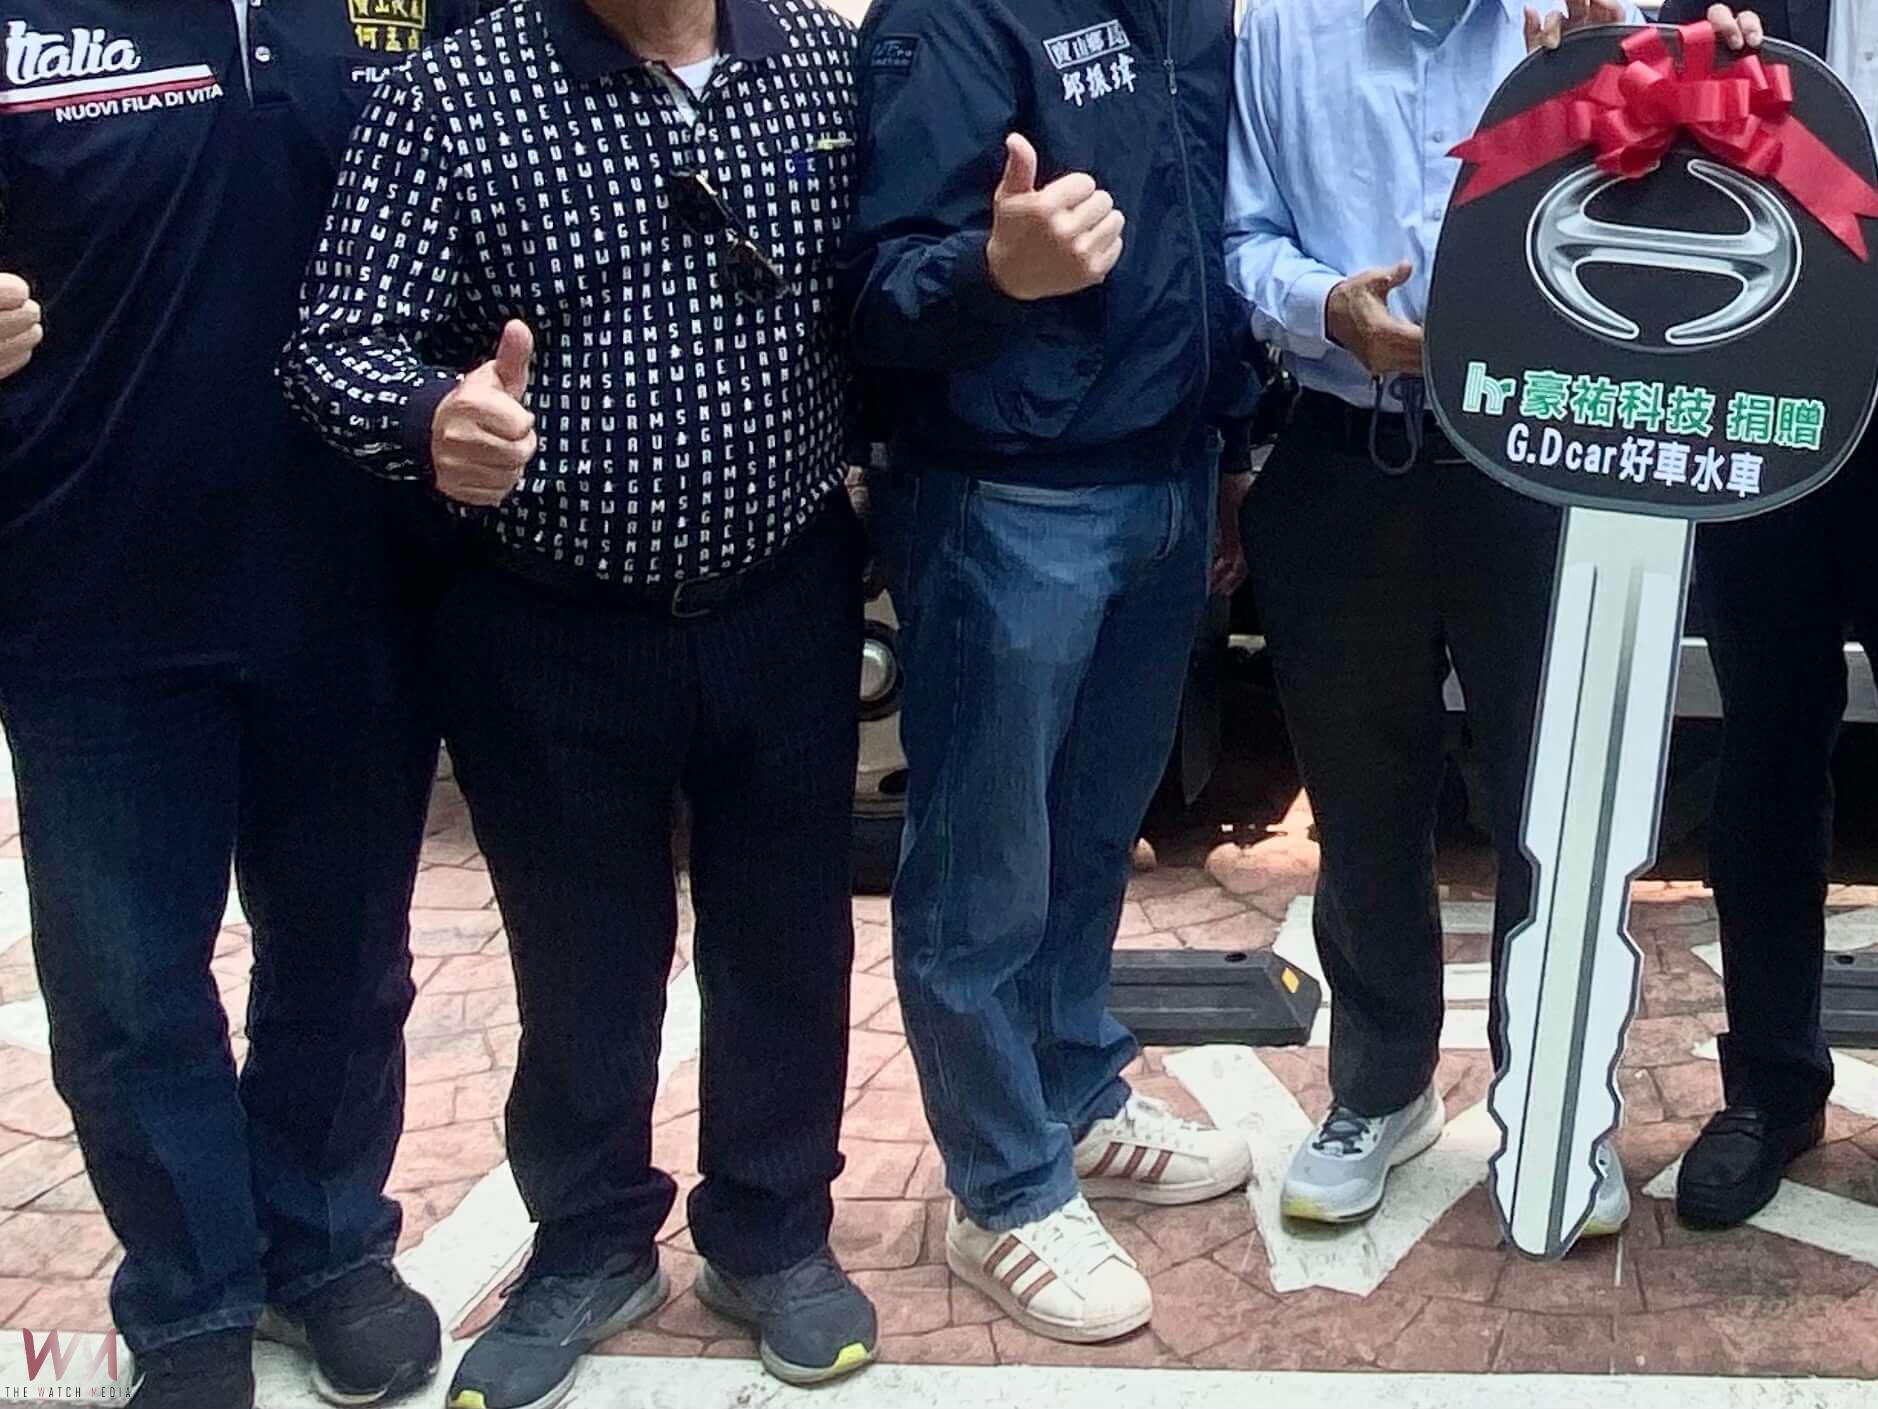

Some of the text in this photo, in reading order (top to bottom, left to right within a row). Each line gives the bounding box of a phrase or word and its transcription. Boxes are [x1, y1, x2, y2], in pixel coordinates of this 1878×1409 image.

[55, 83, 224, 123] NUOVI FILA DI VITA
[1519, 369, 1717, 438] 豪祐科技
[1725, 391, 1826, 451] 捐贈
